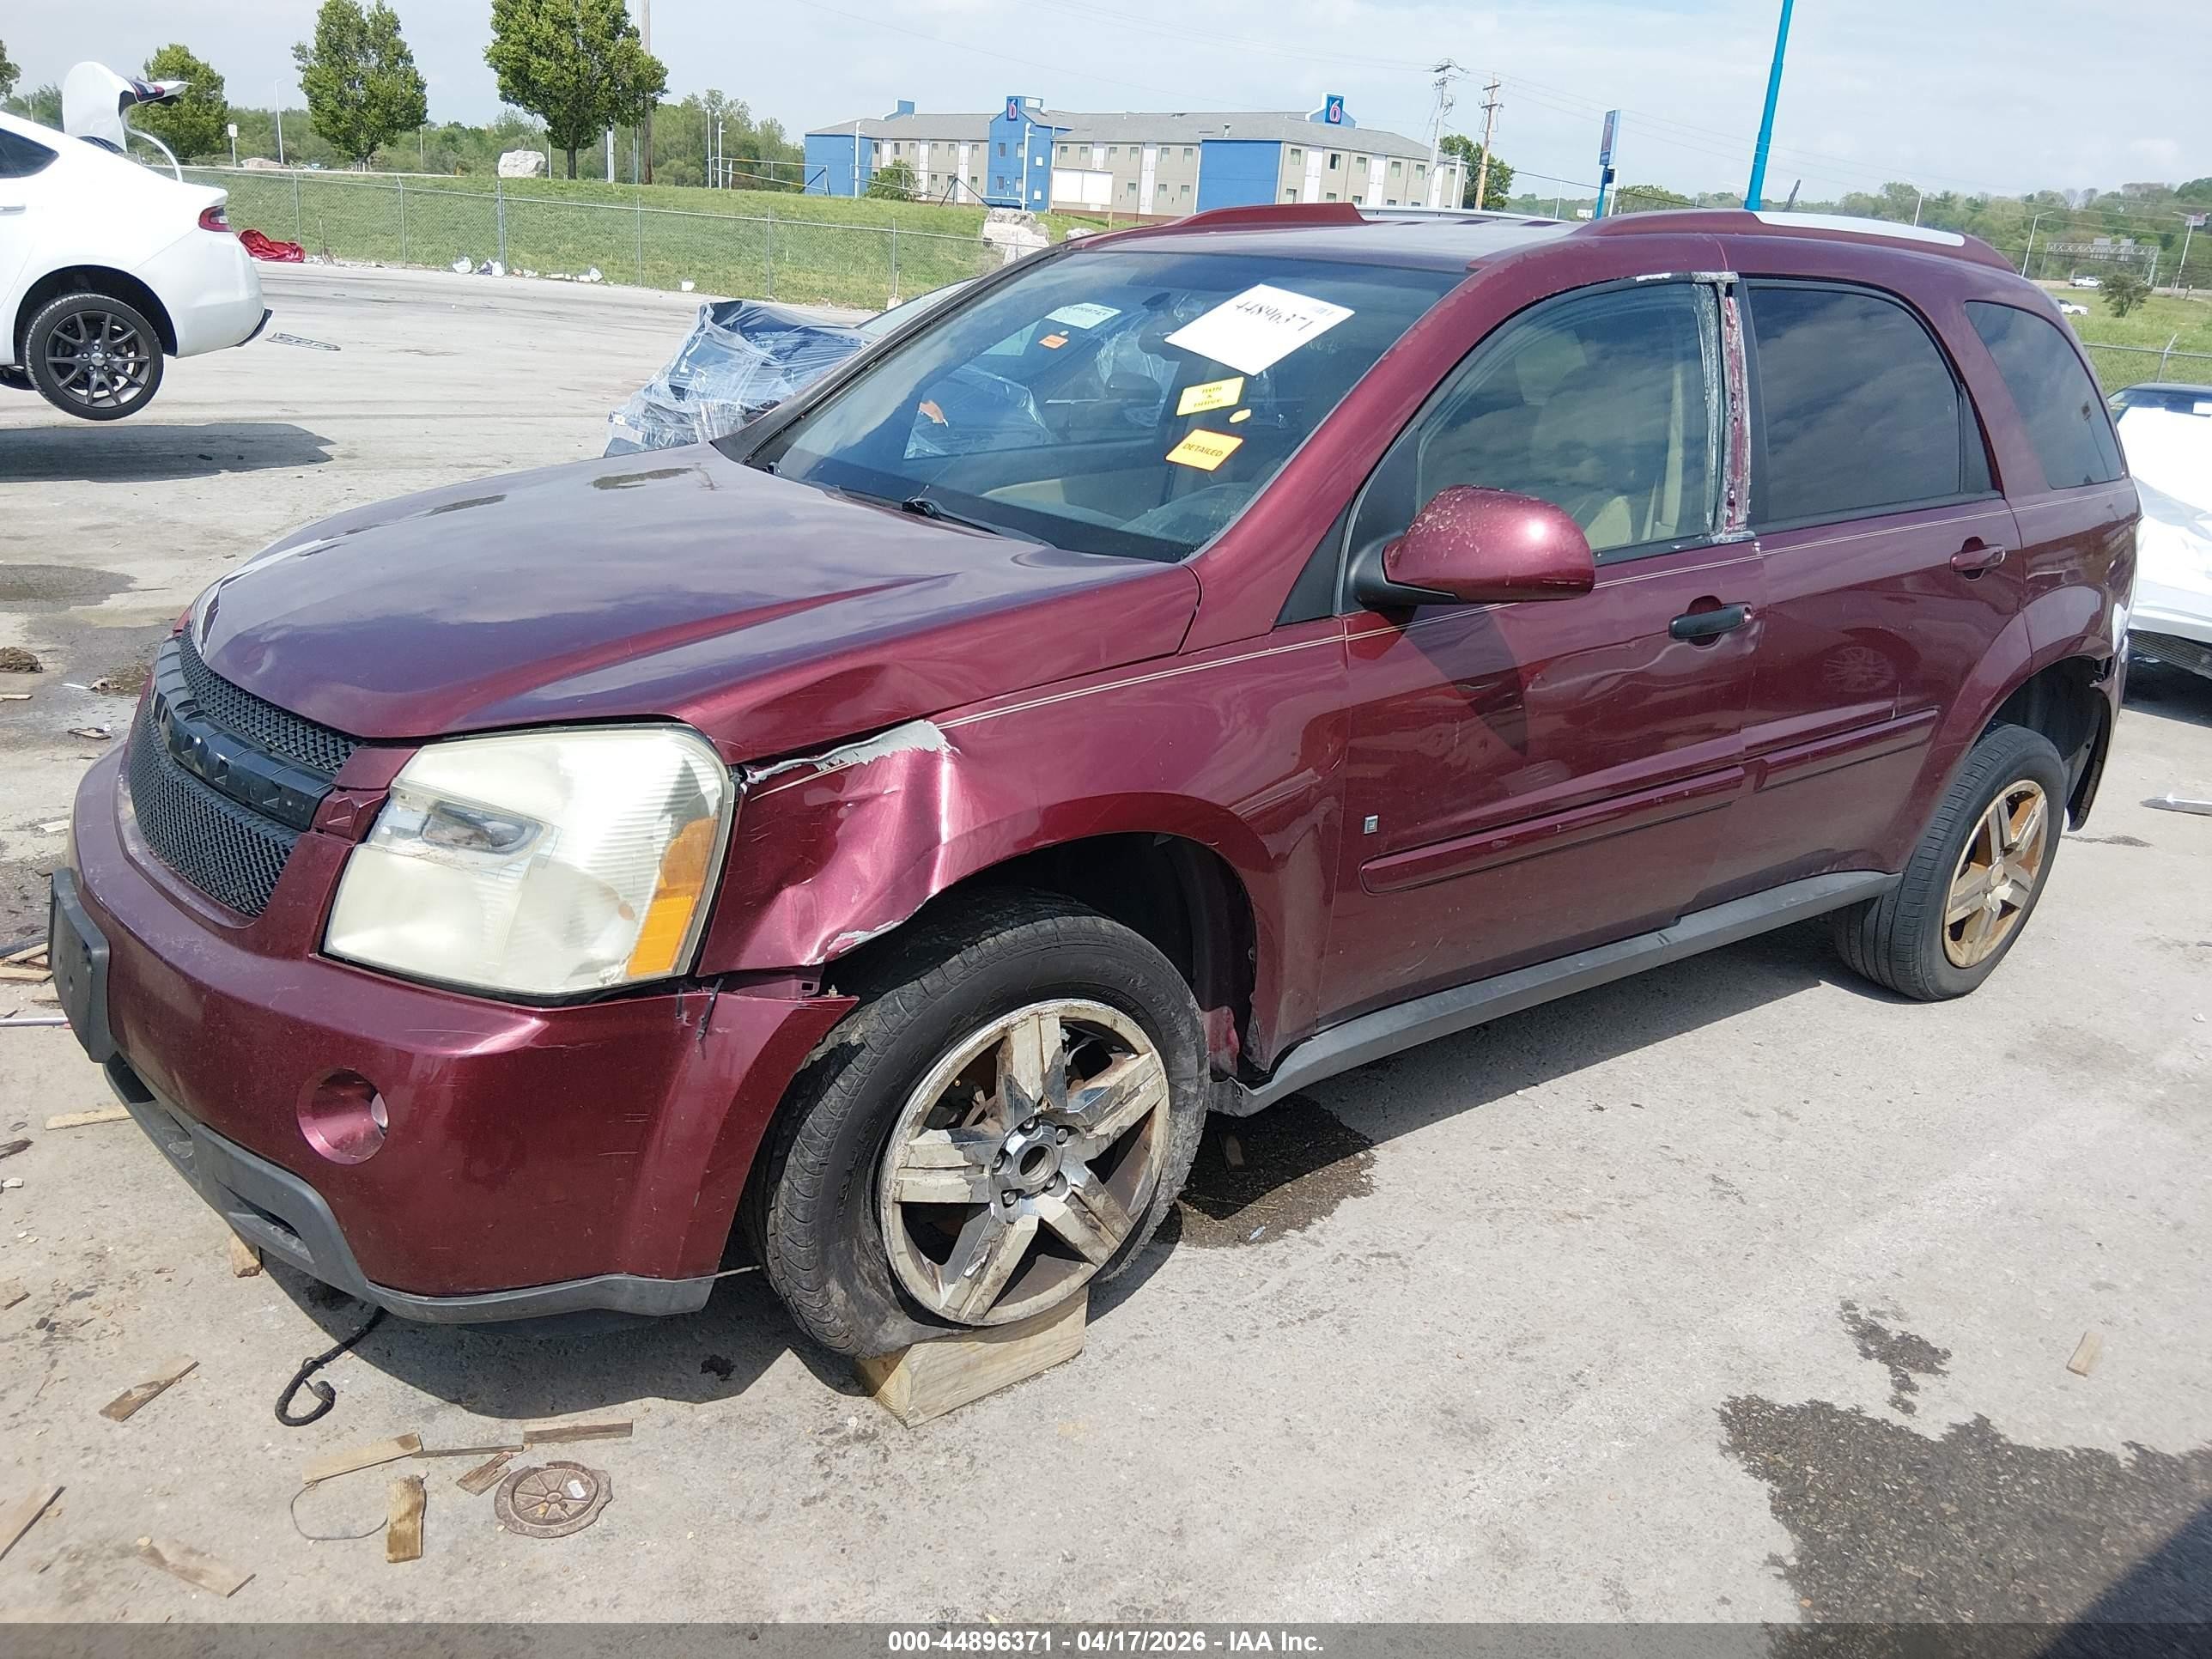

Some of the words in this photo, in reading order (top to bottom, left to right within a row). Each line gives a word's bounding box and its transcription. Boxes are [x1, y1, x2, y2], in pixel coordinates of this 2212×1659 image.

[1008, 99, 1017, 120] 6
[1328, 99, 1341, 123] 6
[1182, 442, 1224, 458] DETAILED
